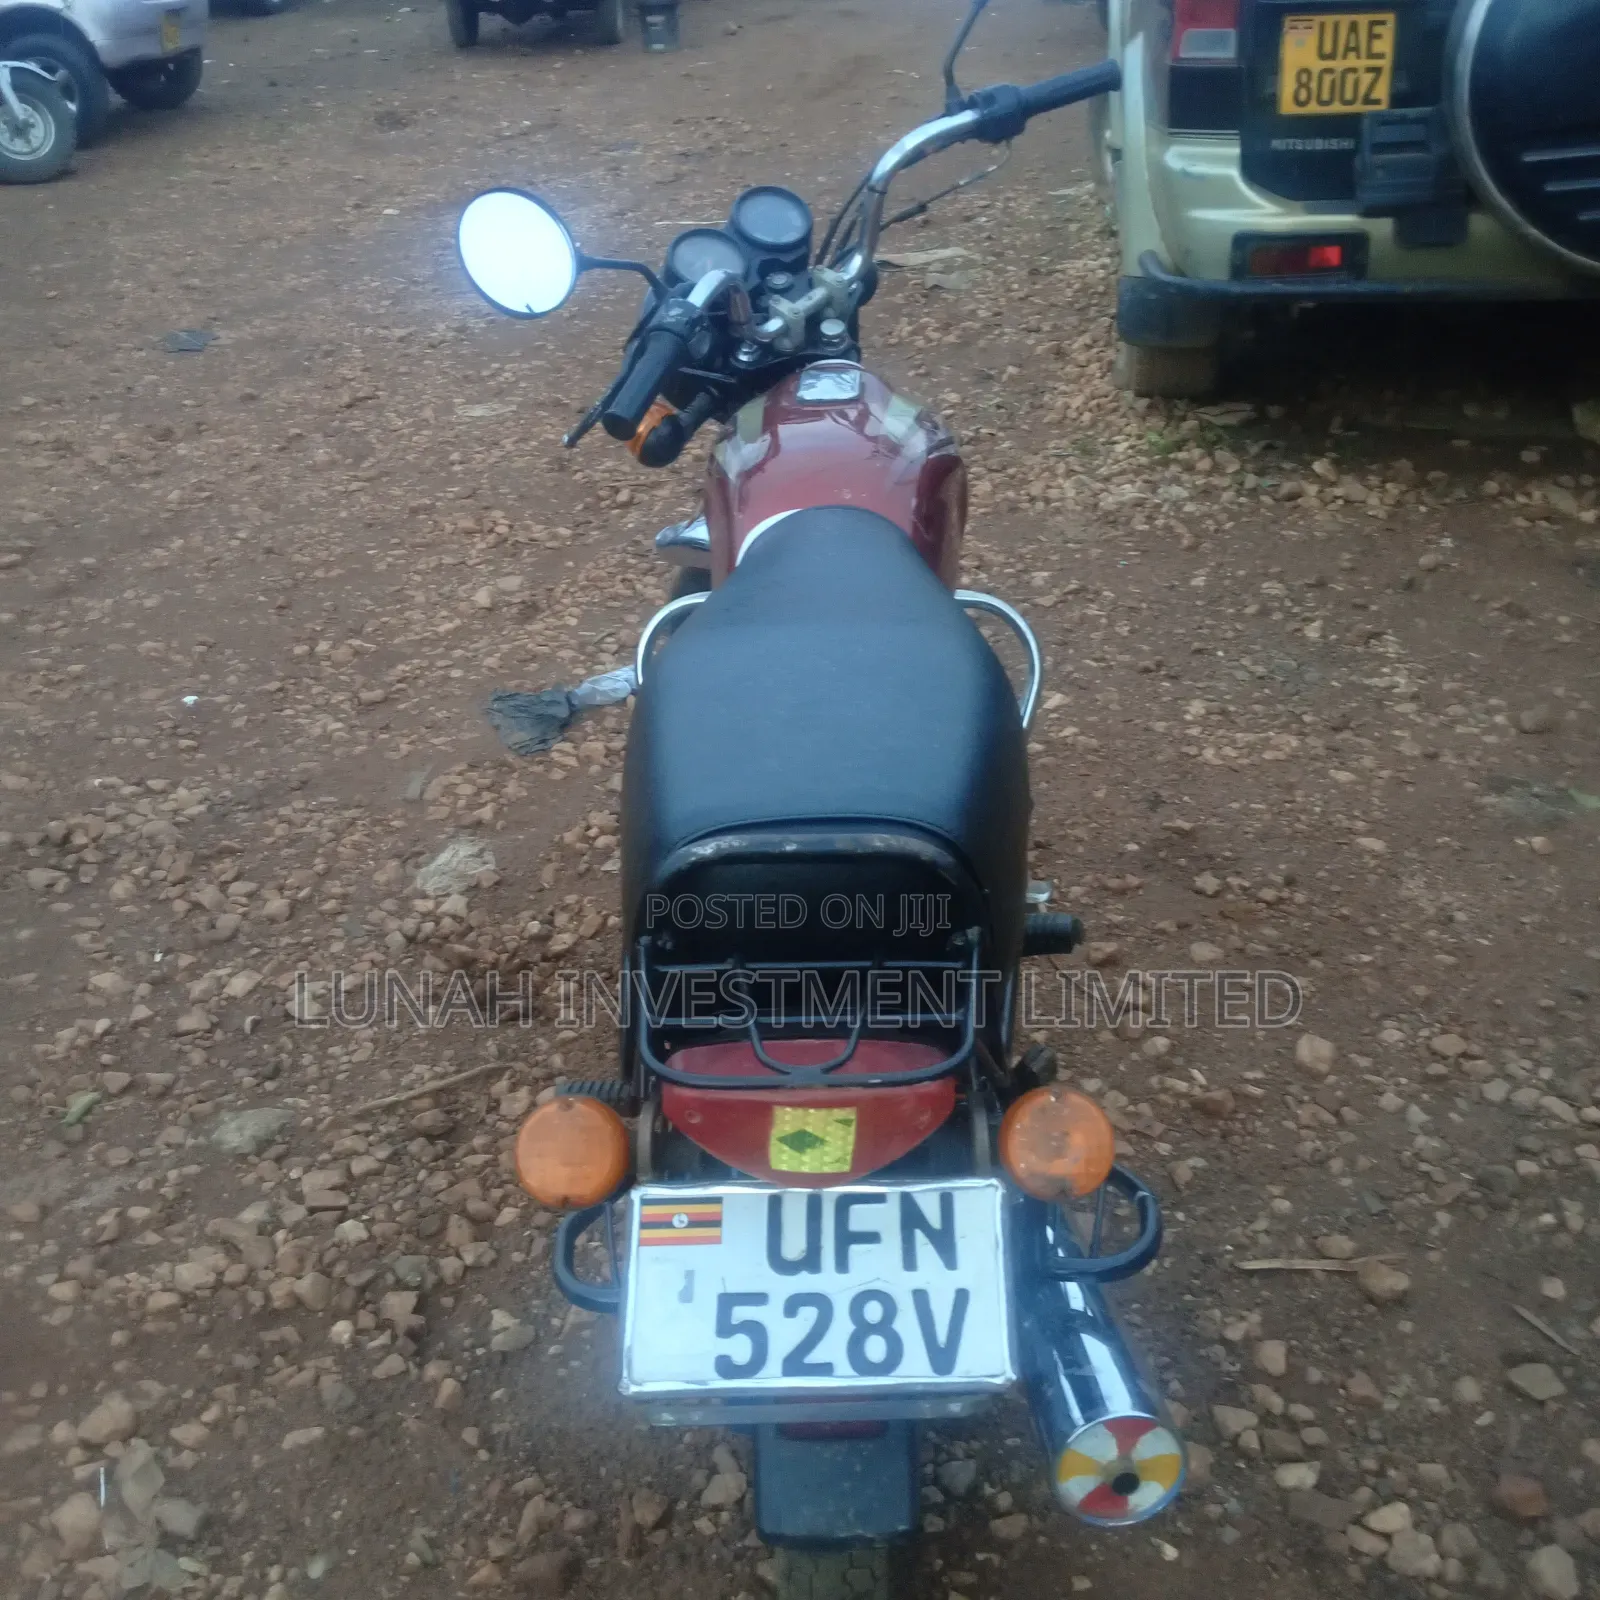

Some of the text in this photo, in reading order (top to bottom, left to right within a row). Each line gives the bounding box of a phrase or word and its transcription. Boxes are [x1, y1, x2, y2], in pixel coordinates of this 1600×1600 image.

[1317, 20, 1388, 61] UAE
[1293, 66, 1384, 108] 800Z
[1271, 138, 1356, 151] MITSUBISHI
[766, 1190, 958, 1276] UFN
[714, 1288, 970, 1379] 528V
